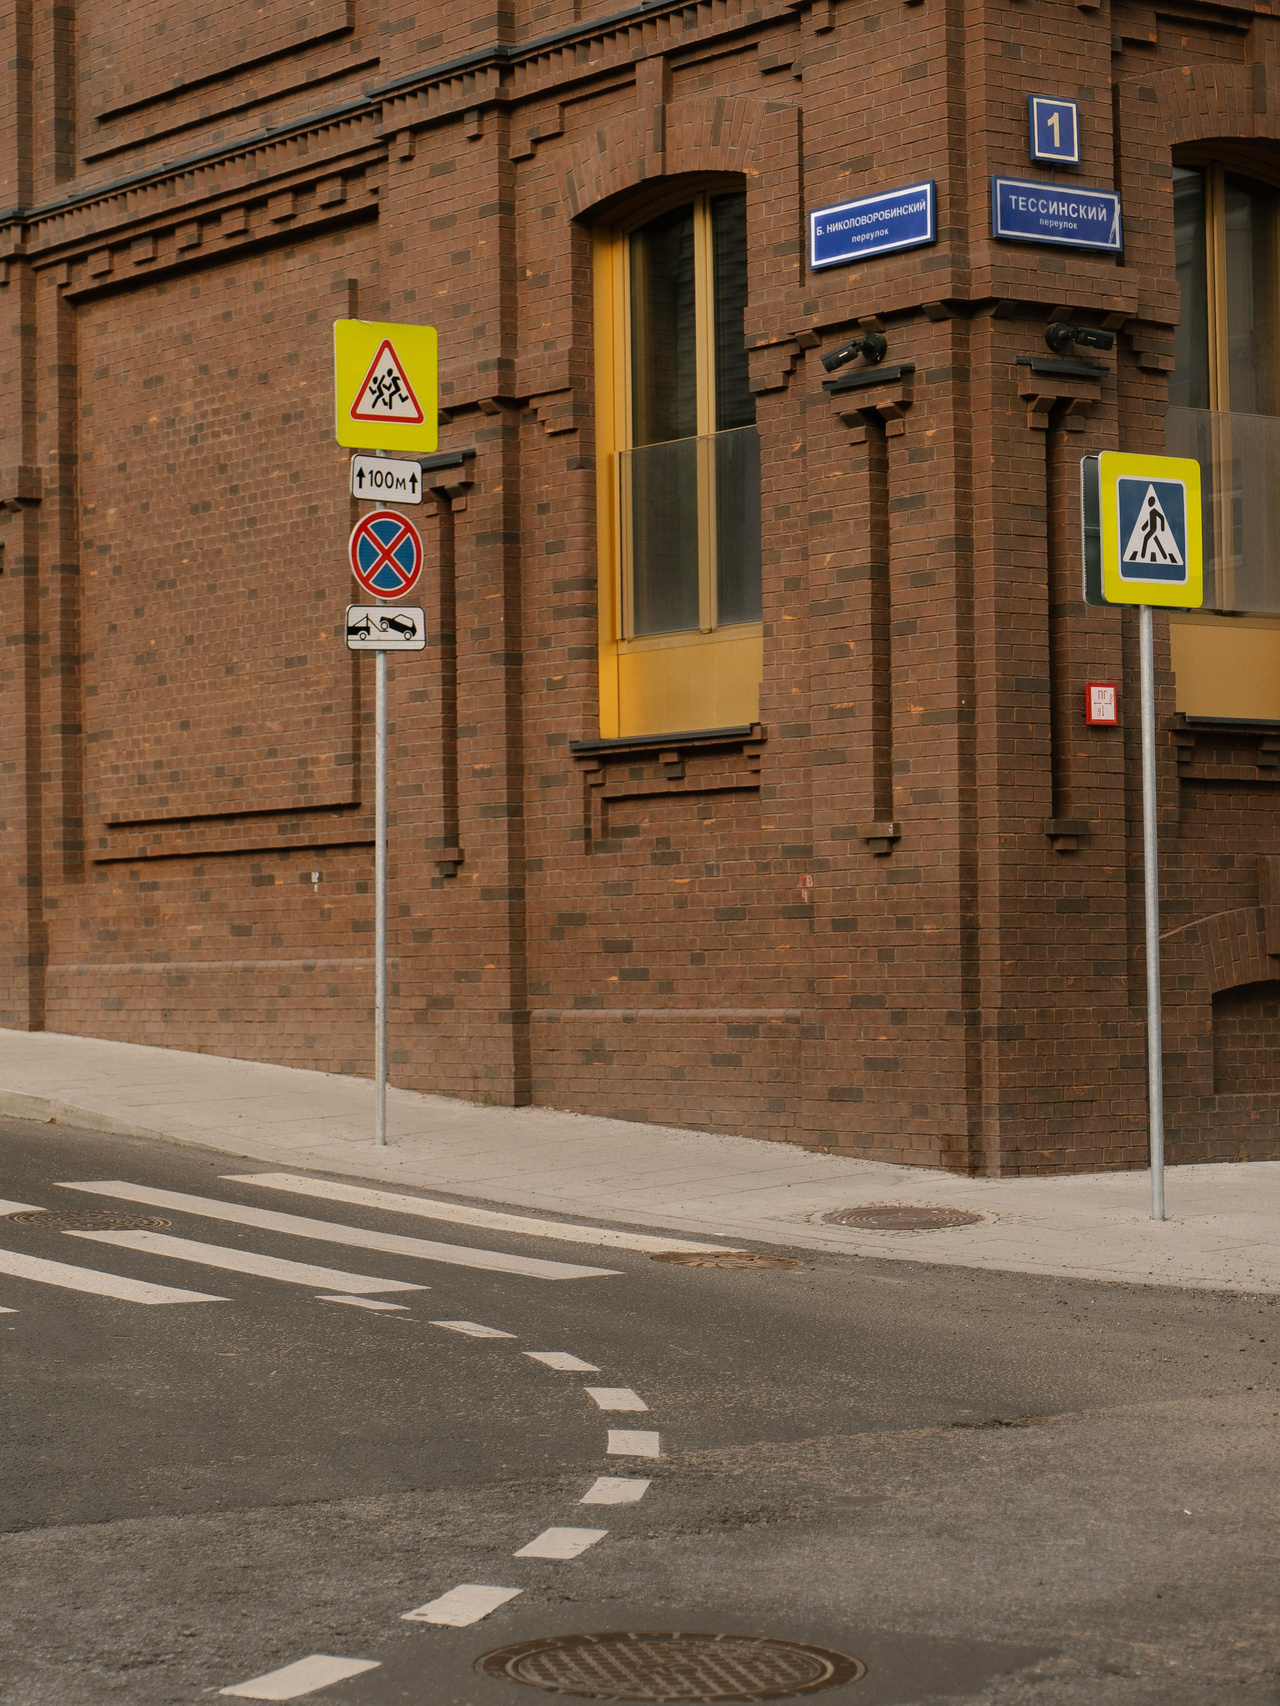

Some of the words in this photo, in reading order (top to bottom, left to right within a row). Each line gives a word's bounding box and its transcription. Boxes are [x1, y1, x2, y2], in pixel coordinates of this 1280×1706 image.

[1047, 112, 1060, 148] 1
[816, 225, 825, 236] Б.
[826, 198, 926, 233] НИКОЛОВОРОБИНСКИЙ
[1009, 195, 1107, 222] ТЕССИНСКИЙ
[851, 228, 889, 243] переулок
[1039, 218, 1078, 230] переулок
